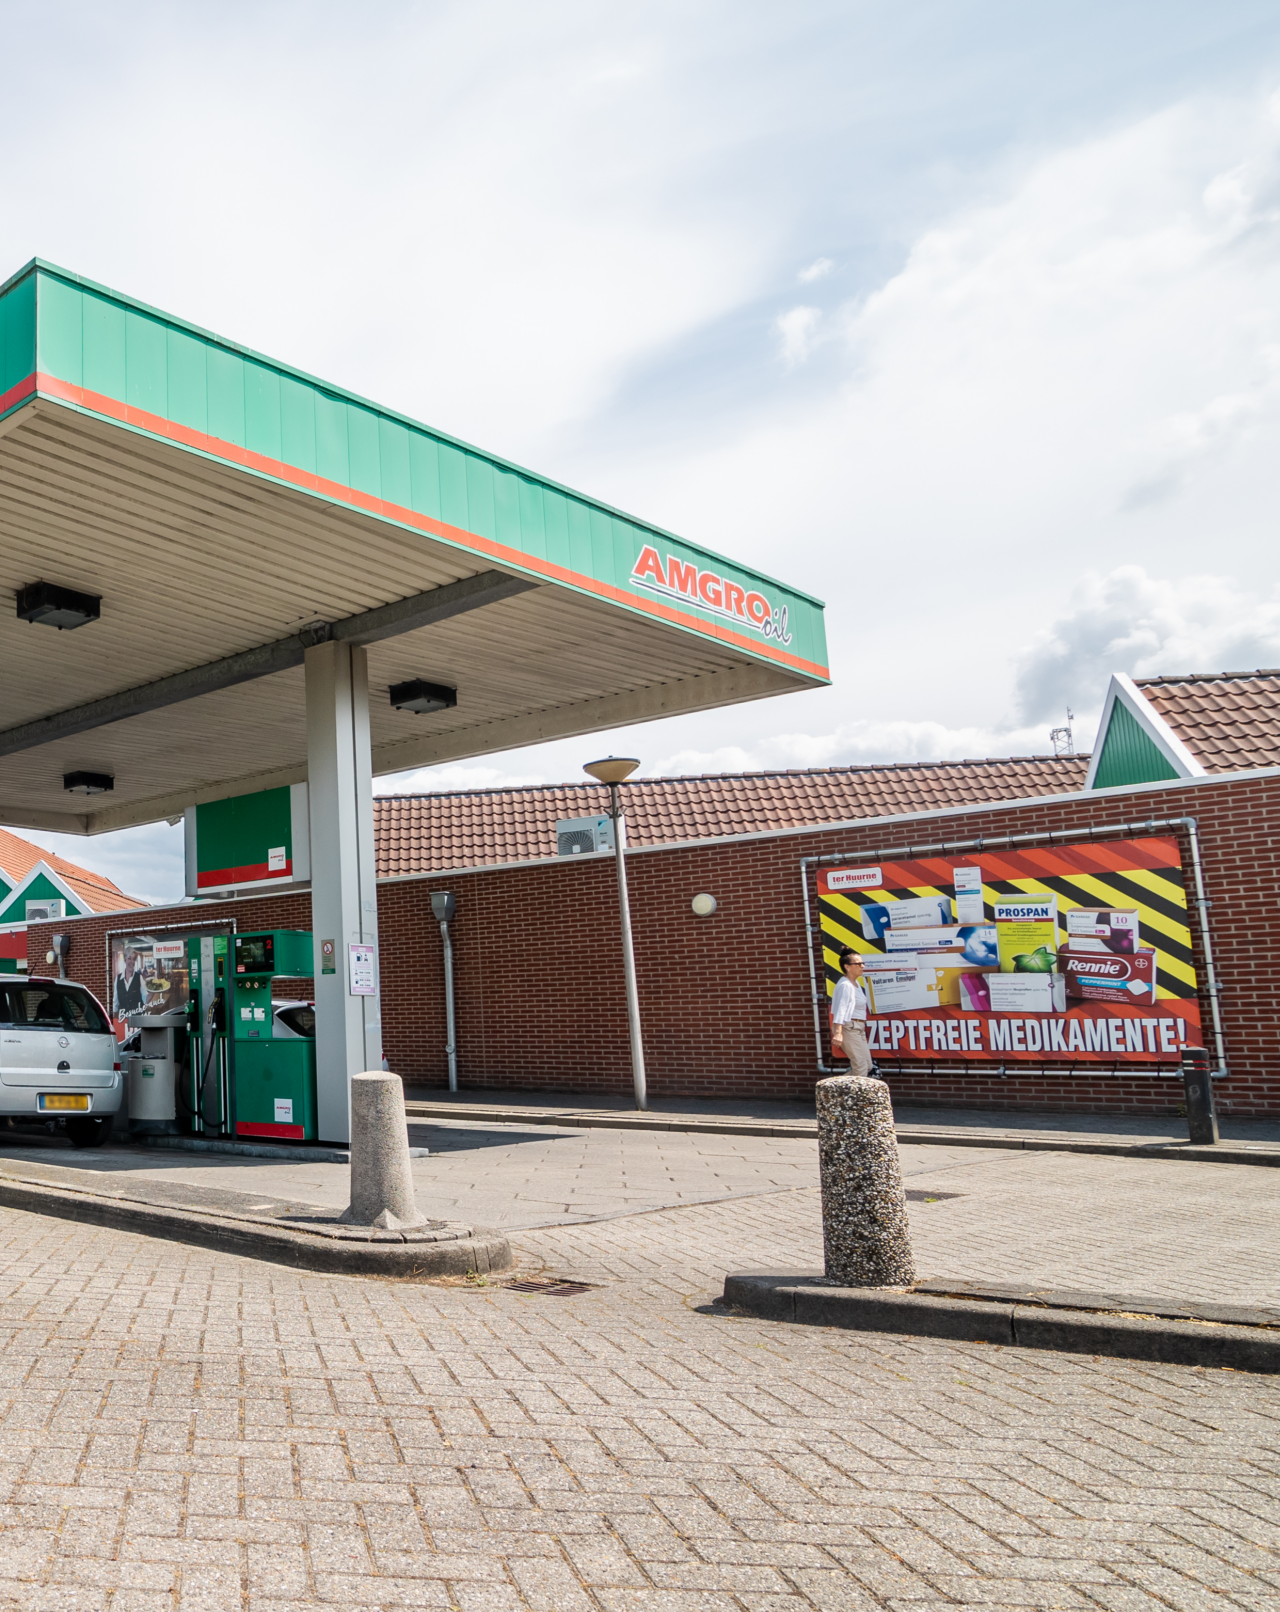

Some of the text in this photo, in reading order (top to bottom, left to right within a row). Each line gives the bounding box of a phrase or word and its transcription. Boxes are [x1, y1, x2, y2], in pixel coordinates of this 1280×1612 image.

[631, 544, 793, 645] AMGRO oil
[846, 873, 877, 881] Huurne
[998, 907, 1049, 917] PROSPAN
[1115, 916, 1128, 924] 10
[266, 940, 272, 949] 2
[1067, 960, 1120, 974] Rennie
[872, 975, 916, 985] Voltaren Emulgel
[117, 993, 166, 1023] Besuche auch
[866, 1018, 1187, 1053] ZEPTFREIE MEDIKAMENTE!
